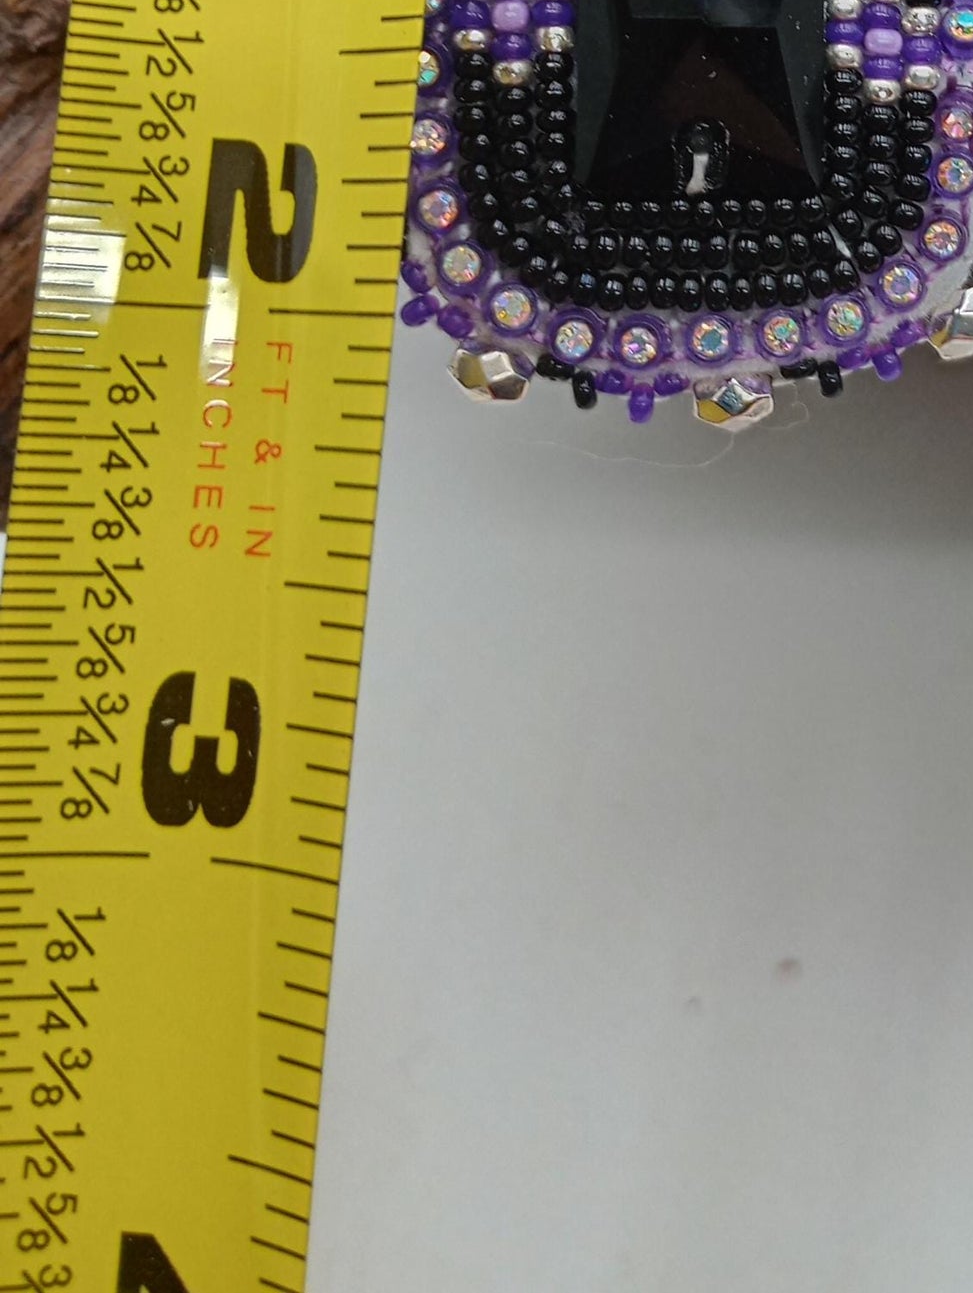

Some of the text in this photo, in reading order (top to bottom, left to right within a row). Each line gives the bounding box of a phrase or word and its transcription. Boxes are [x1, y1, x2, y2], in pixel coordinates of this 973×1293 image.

[145, 28, 204, 78] 1/2
[138, 91, 196, 142] 5/8
[131, 154, 189, 206] 3/4
[197, 137, 318, 284] 2
[124, 221, 182, 272] 7/8
[188, 338, 238, 550] INCHES
[244, 340, 293, 559] FT & IN
[60, 353, 168, 819] 1/8 1/4 3/8 1/2 5/8 3/4 7/8
[141, 670, 262, 829] 3
[45, 907, 106, 963] 1/8
[37, 978, 100, 1035] 1/4
[30, 1046, 93, 1107] 3/8
[23, 1123, 85, 1181] 1/2
[16, 1191, 78, 1252] 5/8
